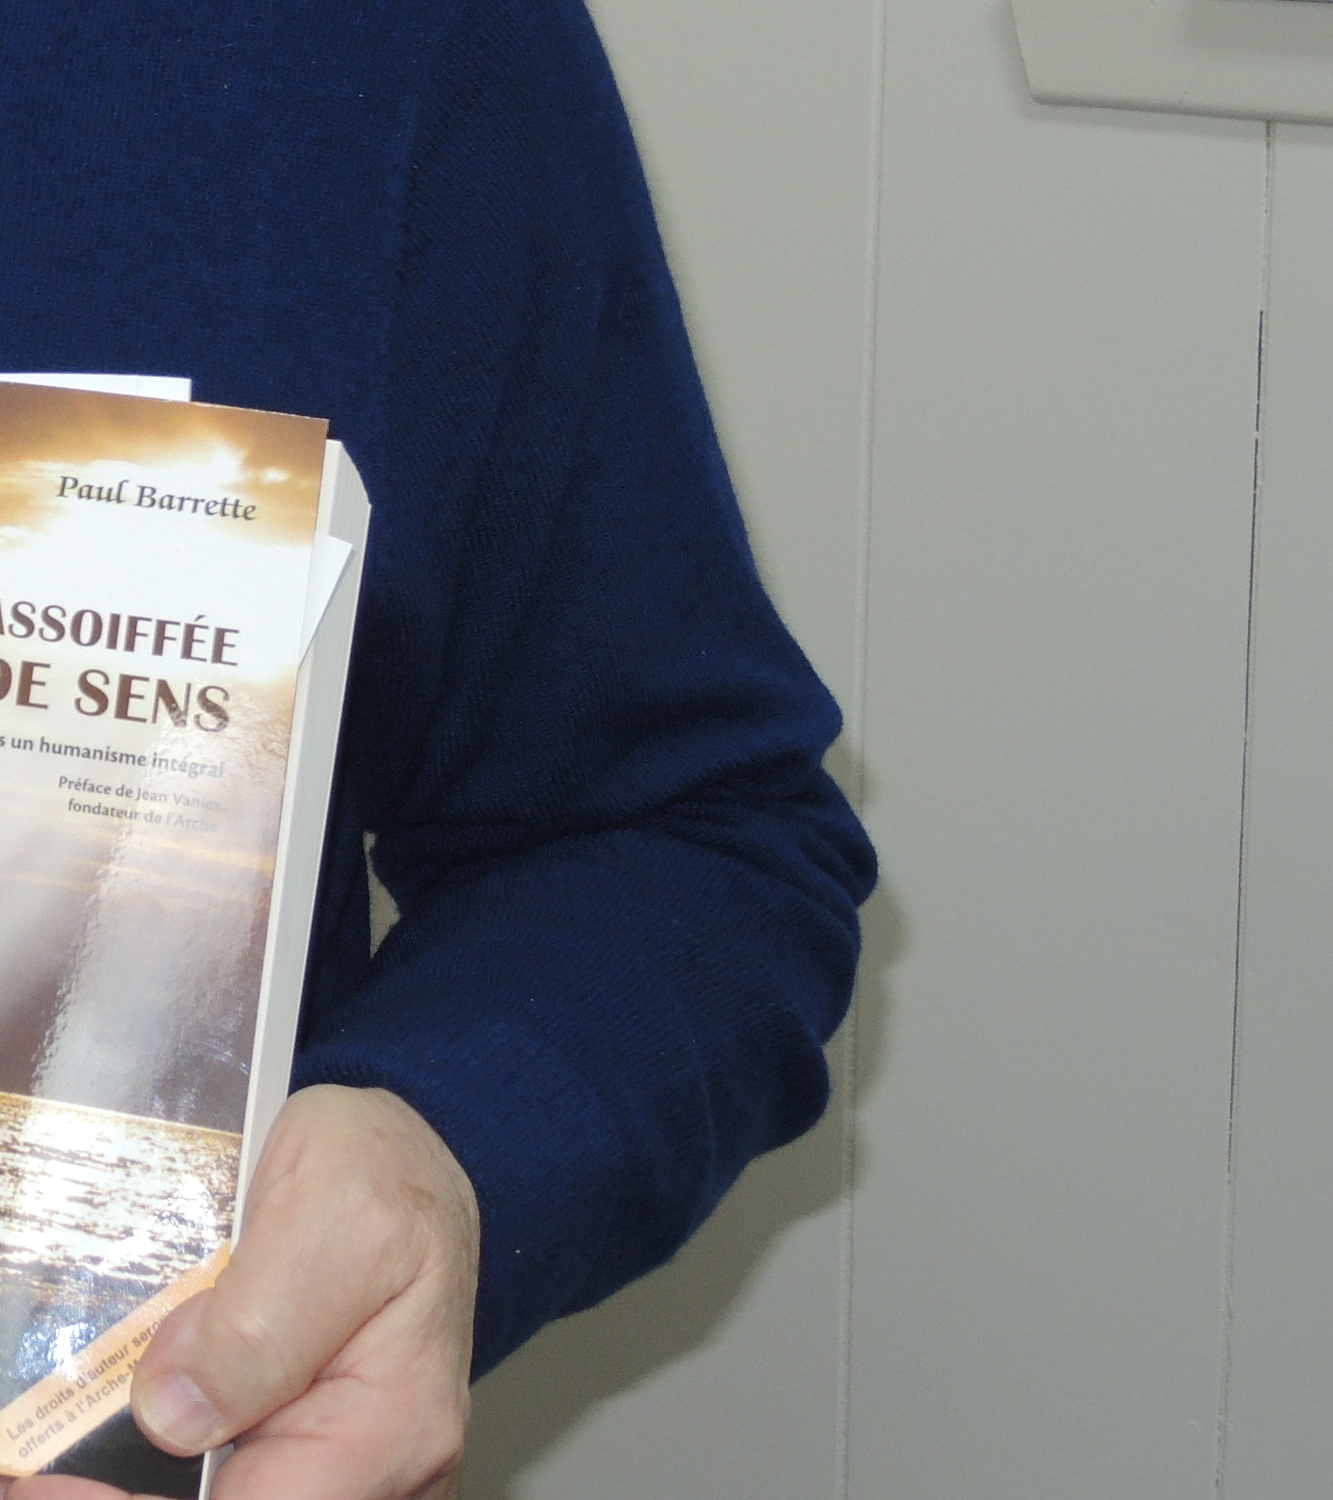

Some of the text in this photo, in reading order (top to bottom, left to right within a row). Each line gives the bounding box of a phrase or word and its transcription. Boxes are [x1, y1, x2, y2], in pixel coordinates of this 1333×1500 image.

[54, 475, 258, 522] Paul Barrette
[73, 668, 231, 733] SENS
[10, 737, 34, 751] un
[39, 736, 147, 767] humanisme
[151, 752, 226, 779] intégral
[57, 775, 112, 796] Préface
[114, 782, 133, 799] de
[134, 786, 168, 805] Jean
[67, 798, 141, 821] fondateur
[144, 808, 162, 825] de
[5, 1319, 165, 1441] Les droits d'auteur sero
[17, 1419, 66, 1459] offerts
[64, 1408, 78, 1424] à
